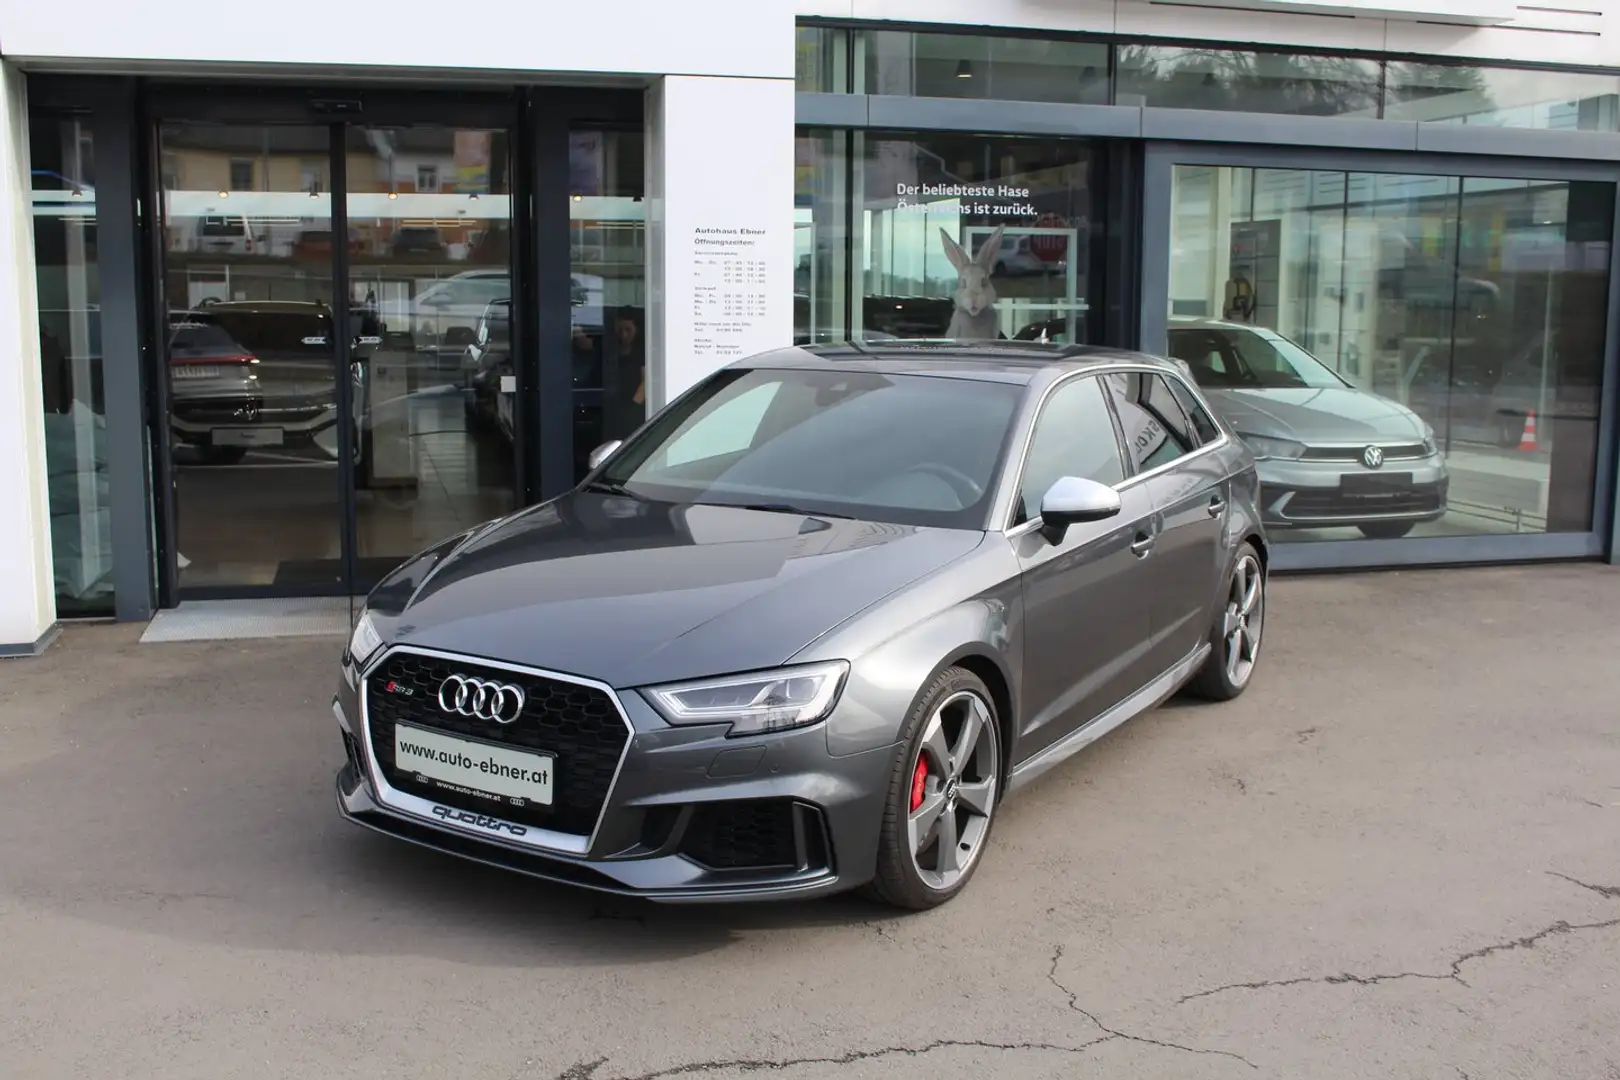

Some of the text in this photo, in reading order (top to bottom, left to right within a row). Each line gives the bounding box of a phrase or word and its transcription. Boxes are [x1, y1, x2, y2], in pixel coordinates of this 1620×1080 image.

[896, 183, 1029, 197] Der beliebteste Hase
[974, 202, 990, 214] ist
[992, 203, 1038, 216] zurück.
[695, 227, 738, 235] Autohaus
[399, 739, 549, 785] www.auto-ebner.at
[436, 780, 502, 803] www.auto-ebner.at
[431, 804, 528, 837] quattro
